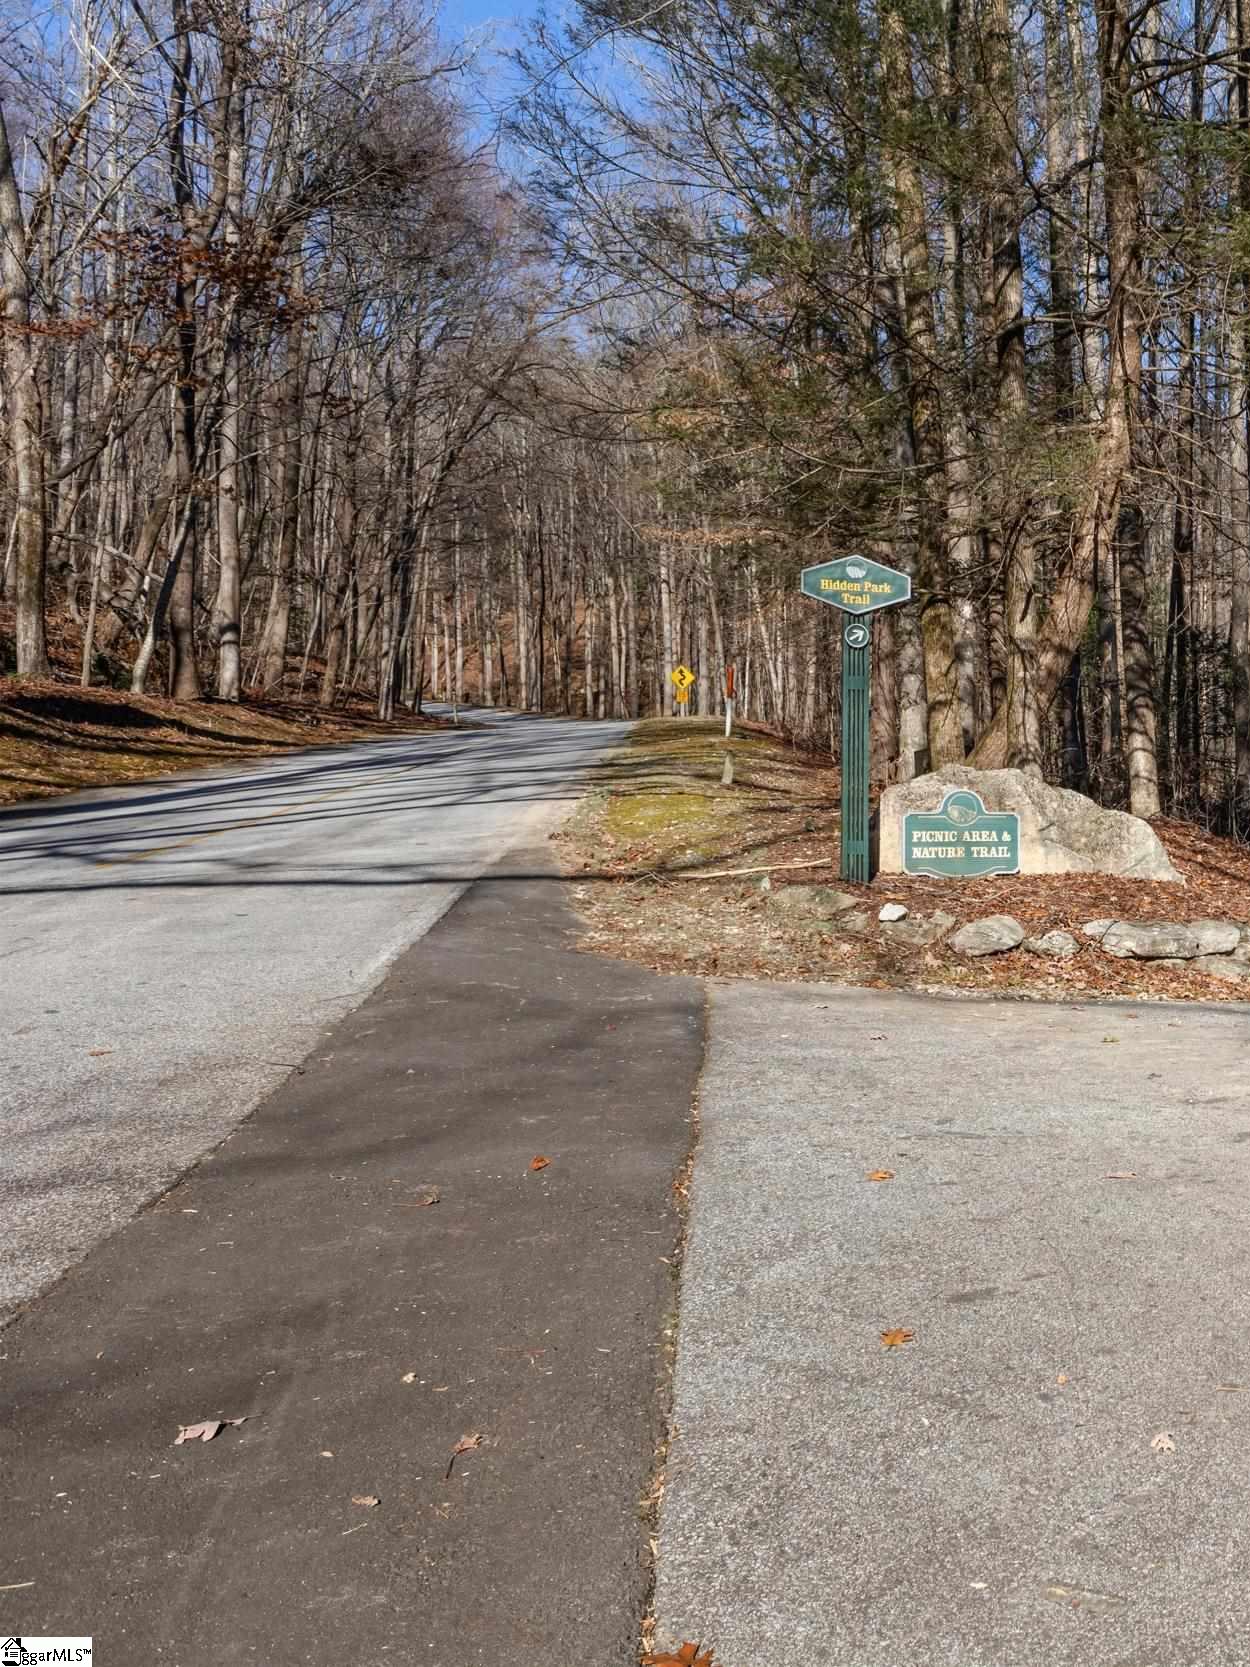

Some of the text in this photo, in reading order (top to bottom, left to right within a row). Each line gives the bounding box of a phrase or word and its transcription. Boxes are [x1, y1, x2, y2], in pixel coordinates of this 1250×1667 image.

[820, 579, 892, 593] Hidden Park
[842, 592, 870, 605] Trail
[911, 830, 1012, 842] PICNIC AREA &
[911, 846, 1011, 858] NATURE TRAIL
